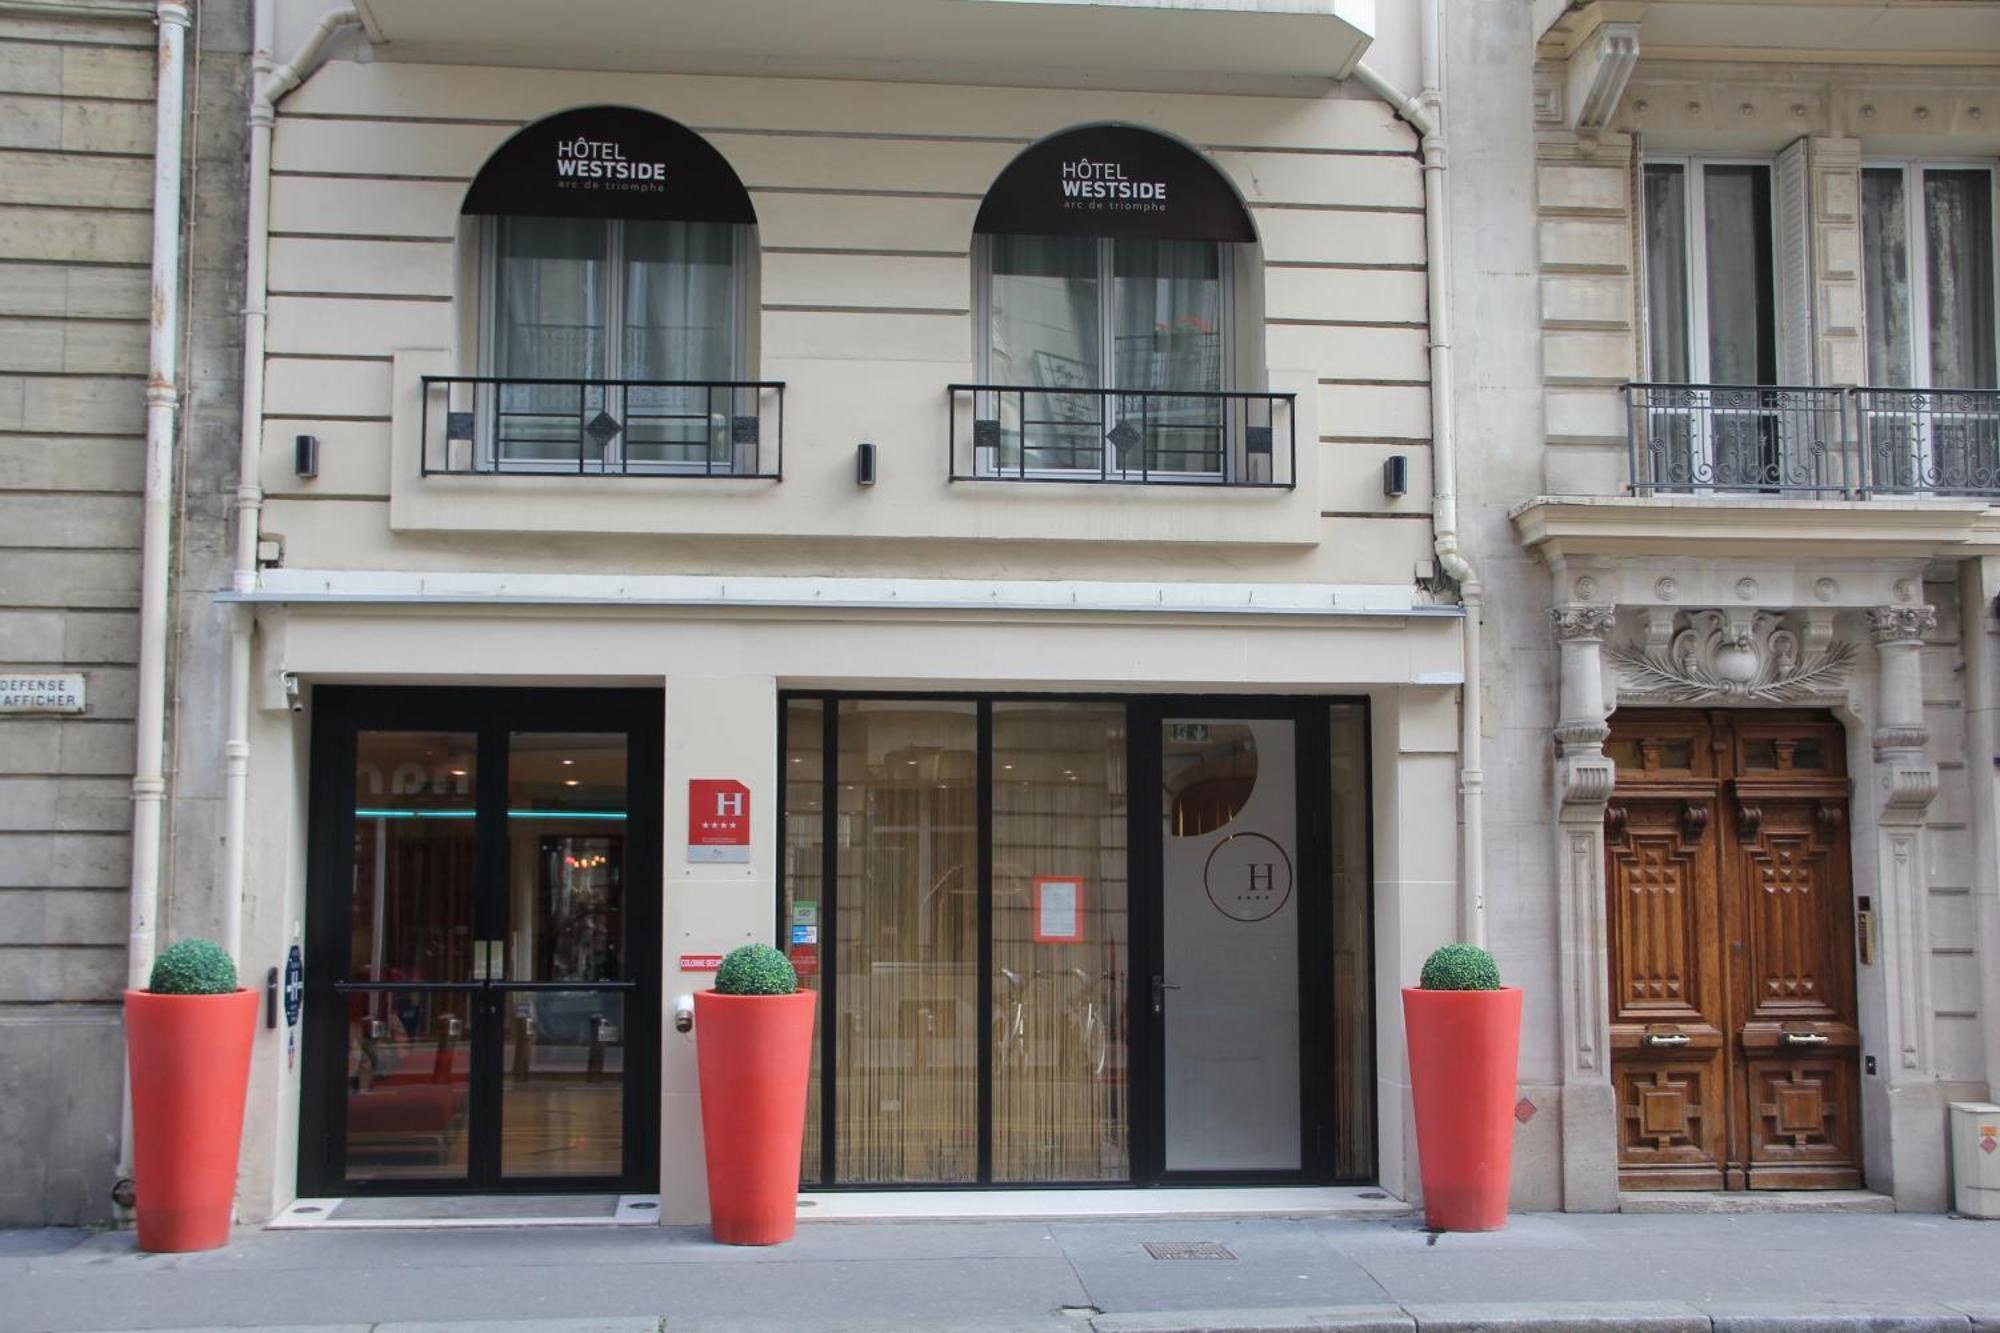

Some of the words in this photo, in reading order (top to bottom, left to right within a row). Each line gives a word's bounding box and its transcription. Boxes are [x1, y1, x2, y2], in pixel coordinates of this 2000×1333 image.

[558, 136, 626, 160] HÔTEL
[557, 159, 666, 180] WESTSIDE
[1062, 158, 1128, 180] HÔTEL
[558, 181, 577, 189] arc
[584, 181, 599, 190] de
[605, 182, 665, 192] triomphe
[1062, 180, 1166, 200] WESTSIDE
[1064, 201, 1083, 209] arc
[1088, 200, 1103, 210] de
[1109, 202, 1166, 213] triomphe
[0, 680, 65, 691] DEFENSE
[715, 792, 744, 817] H
[1247, 863, 1274, 890] H
